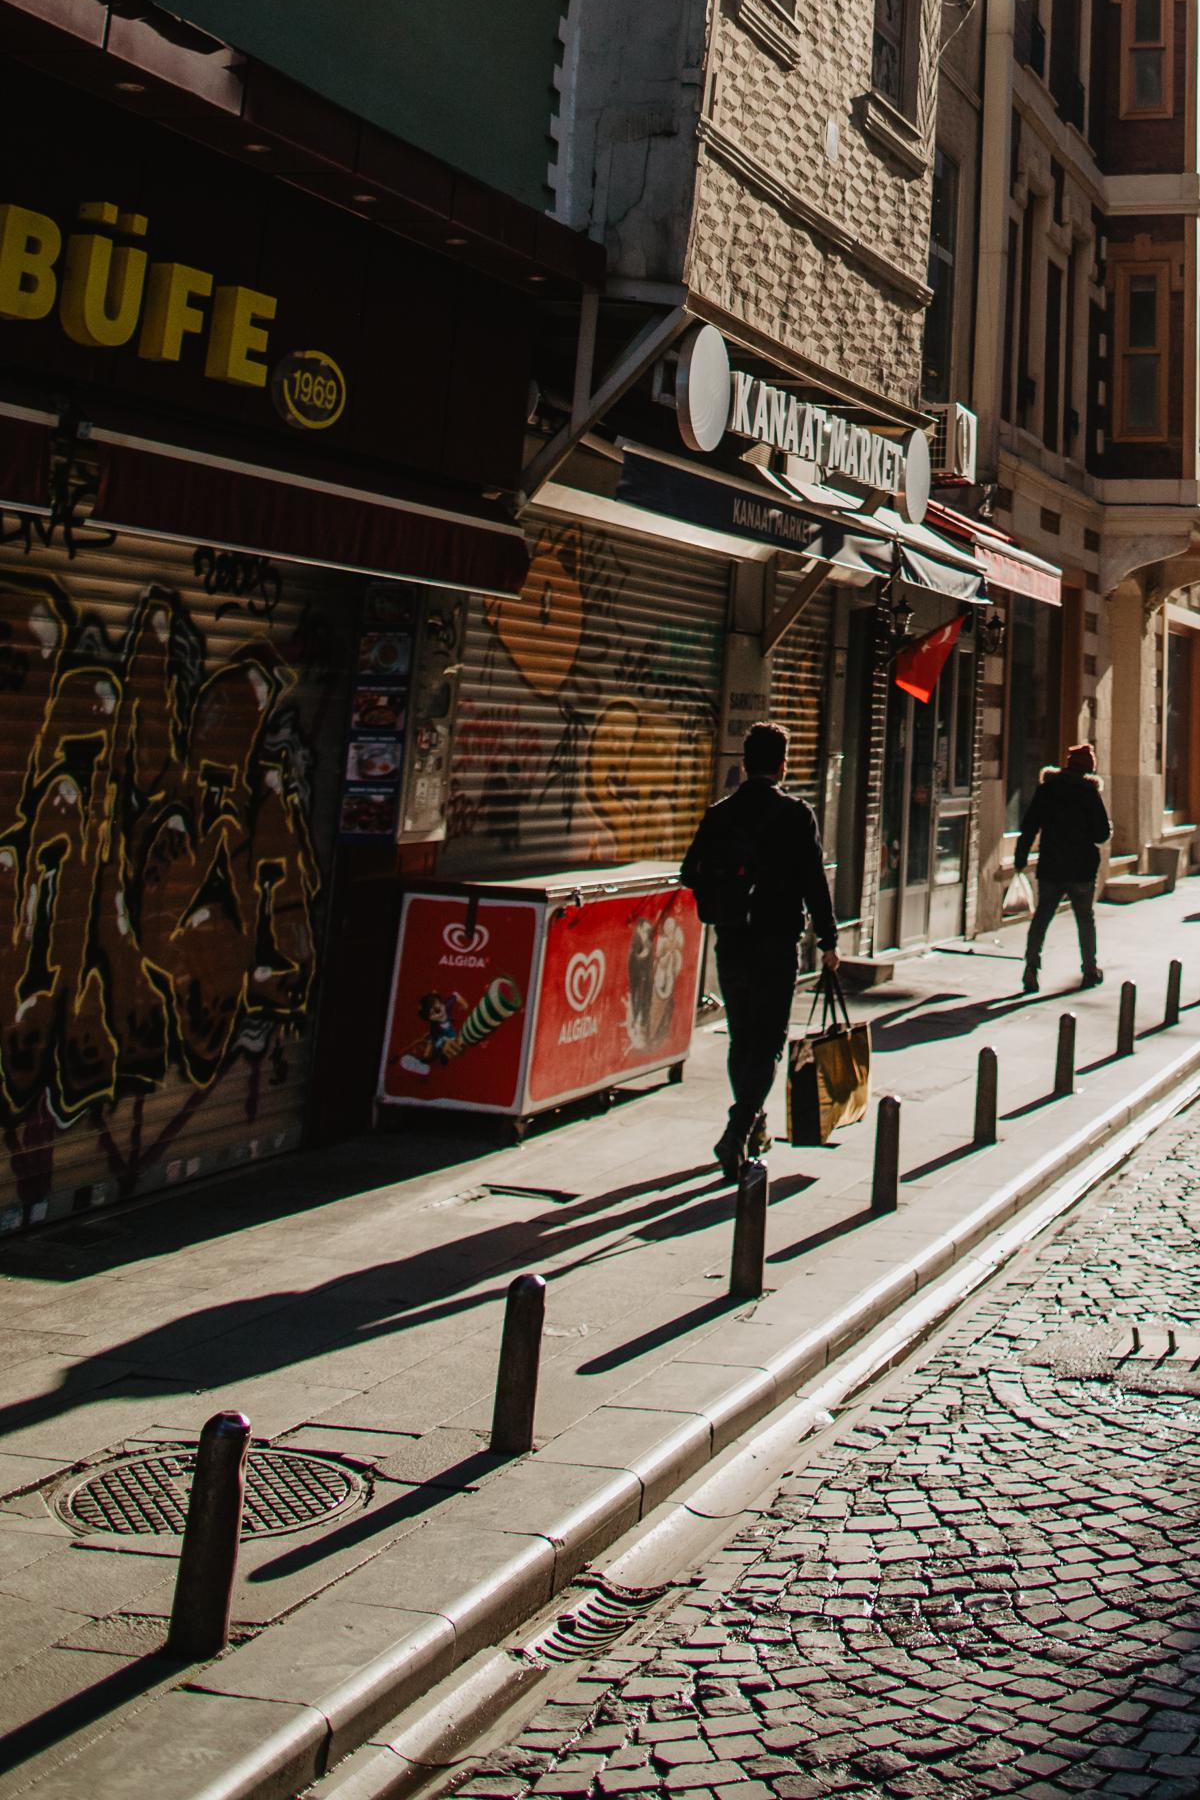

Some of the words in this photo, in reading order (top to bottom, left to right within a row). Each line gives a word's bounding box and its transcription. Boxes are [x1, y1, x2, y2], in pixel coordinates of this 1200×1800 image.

[0, 201, 279, 388] BÜFE
[292, 370, 338, 411] 1969
[731, 370, 828, 469] KANAAT
[828, 413, 905, 496] MARKET
[732, 497, 775, 535] KANAAT
[438, 954, 487, 969] ALGIDA
[558, 1015, 599, 1046] ALGIDA
